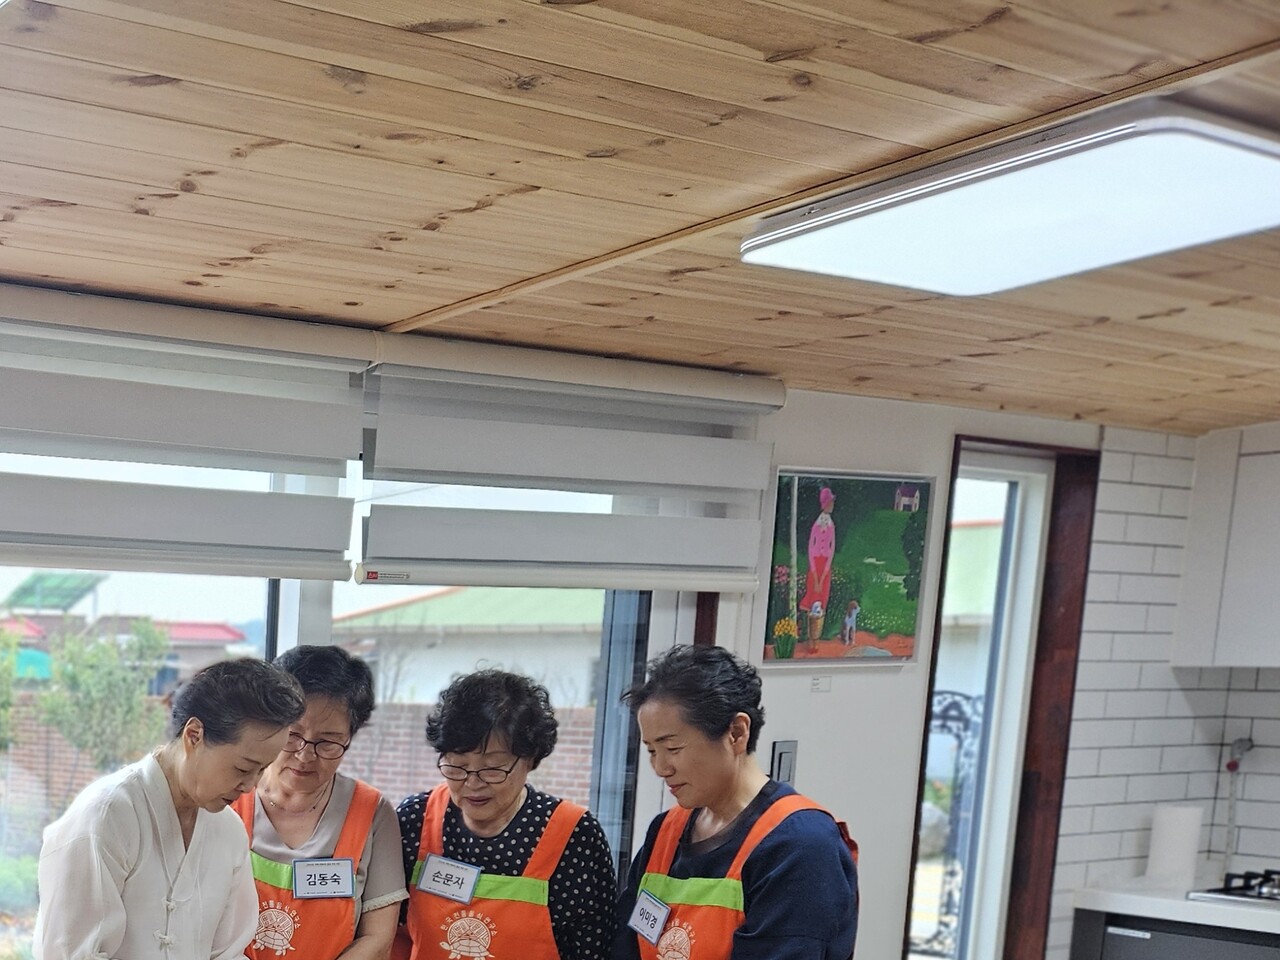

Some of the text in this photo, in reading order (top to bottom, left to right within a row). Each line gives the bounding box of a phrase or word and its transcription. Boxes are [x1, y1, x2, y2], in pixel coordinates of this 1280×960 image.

[306, 873, 341, 886] 김동숙
[432, 870, 465, 890] 손문자
[259, 900, 301, 929] 전통음식연구소
